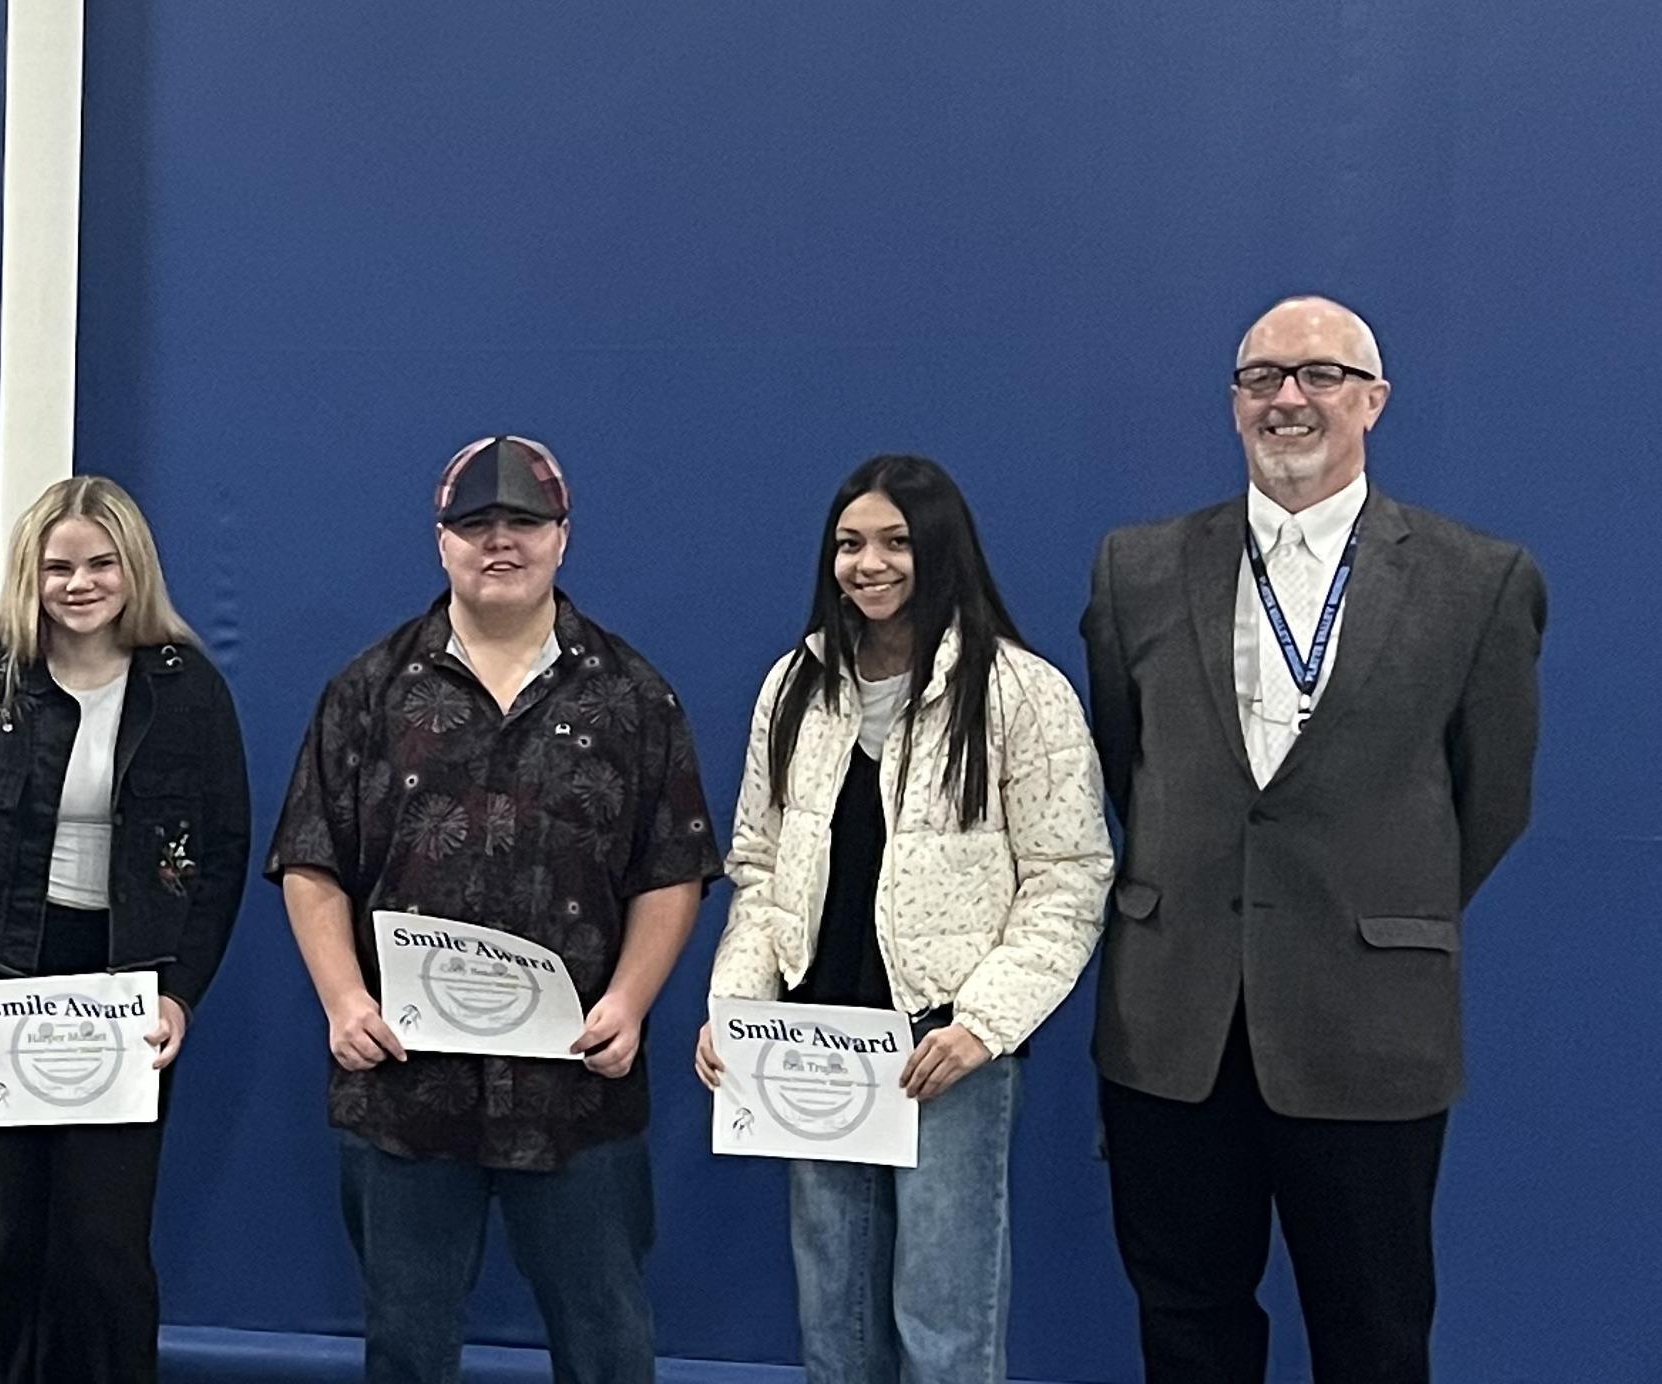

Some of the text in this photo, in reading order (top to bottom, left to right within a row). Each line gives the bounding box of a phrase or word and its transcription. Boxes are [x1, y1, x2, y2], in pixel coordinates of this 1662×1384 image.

[393, 928, 467, 953] Smile
[475, 941, 556, 974] Award
[65, 994, 146, 1019] Award
[728, 1019, 899, 1053] Smile Award
